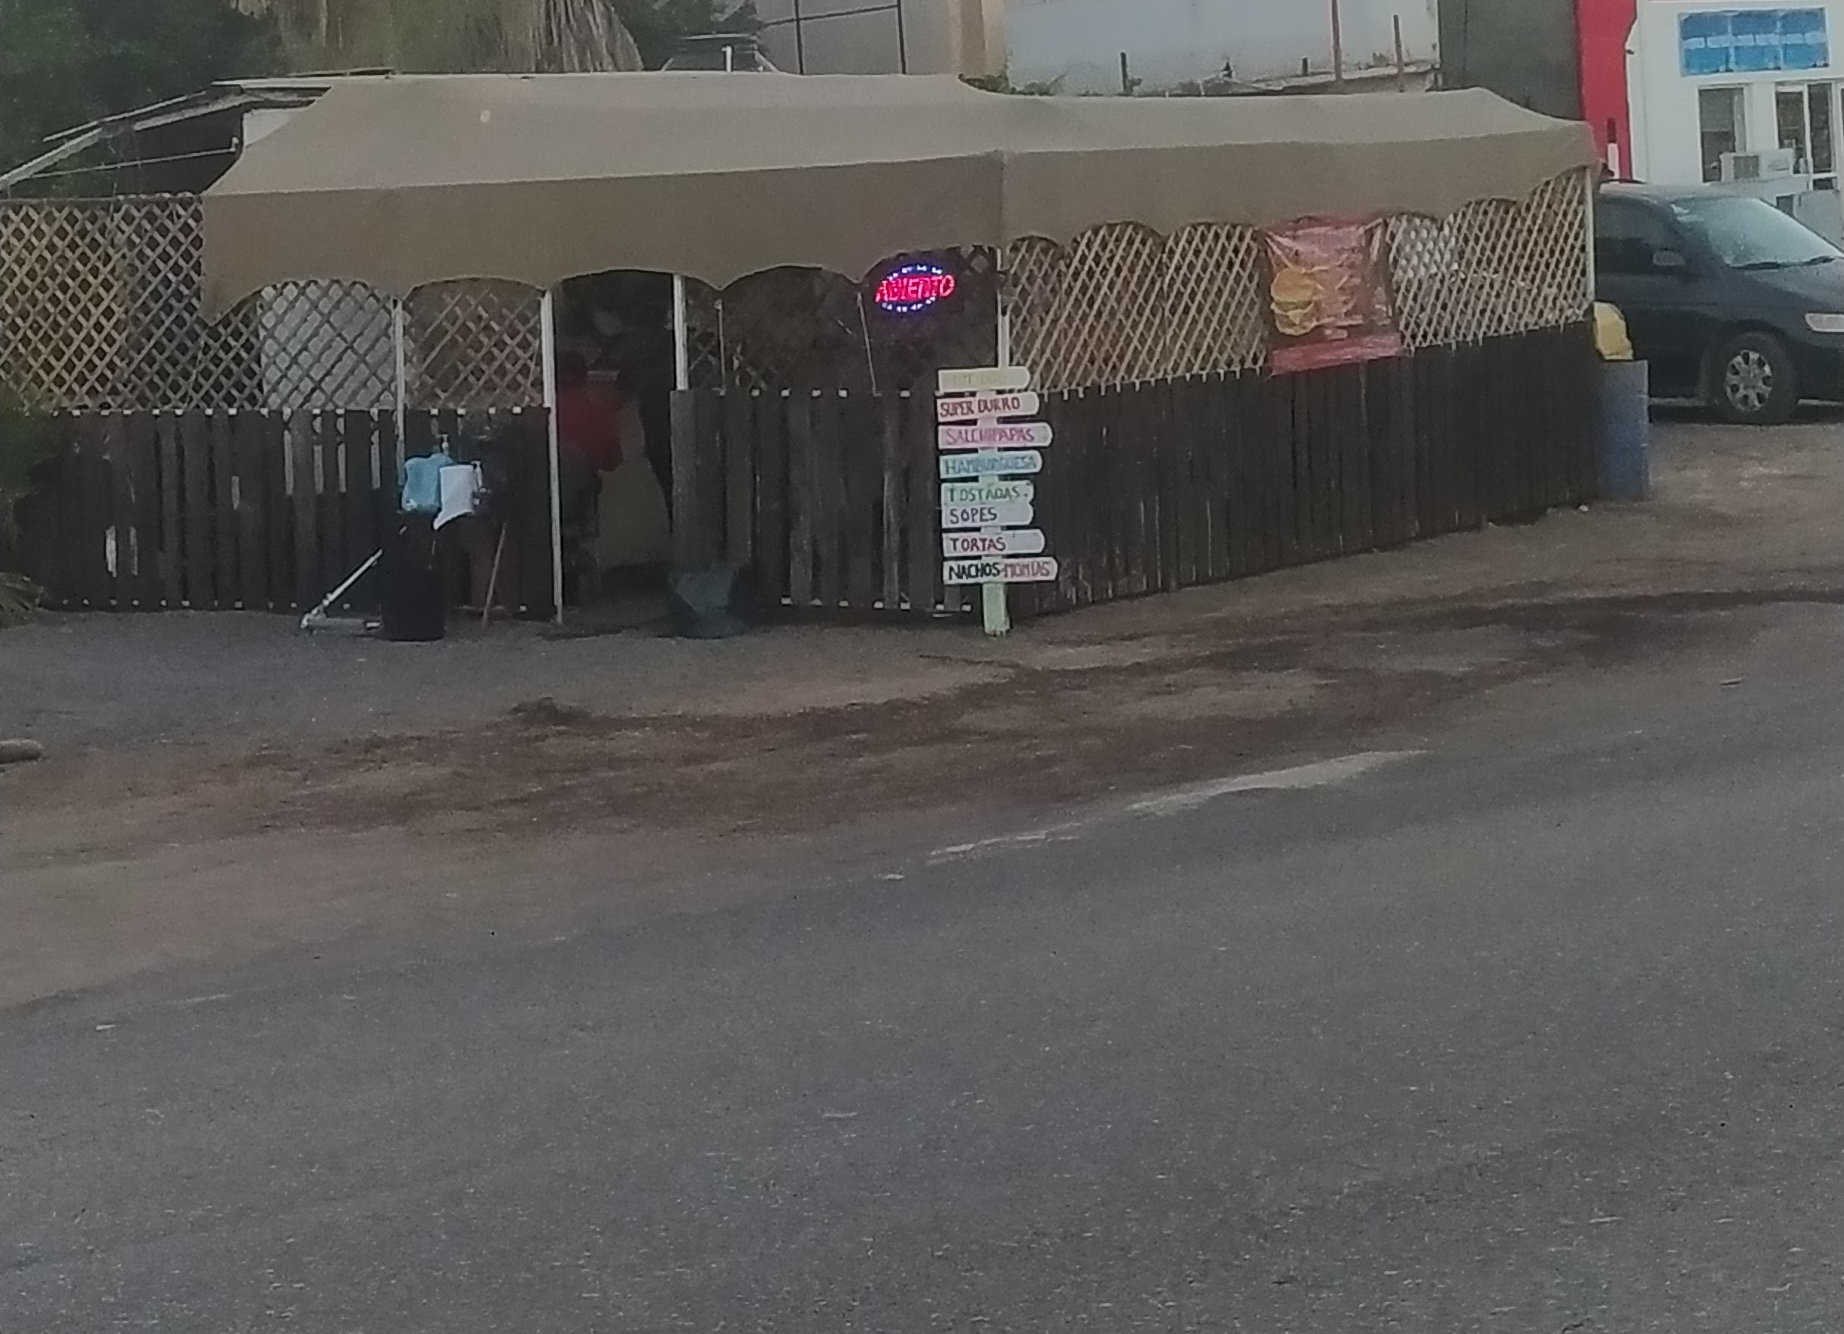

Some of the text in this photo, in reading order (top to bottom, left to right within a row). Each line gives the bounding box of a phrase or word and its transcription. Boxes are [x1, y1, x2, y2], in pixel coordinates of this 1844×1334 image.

[875, 274, 955, 303] ABIERTO
[949, 486, 1020, 502] TOSTADAS
[949, 507, 998, 524] SOPES
[950, 537, 1006, 552] TORTAS
